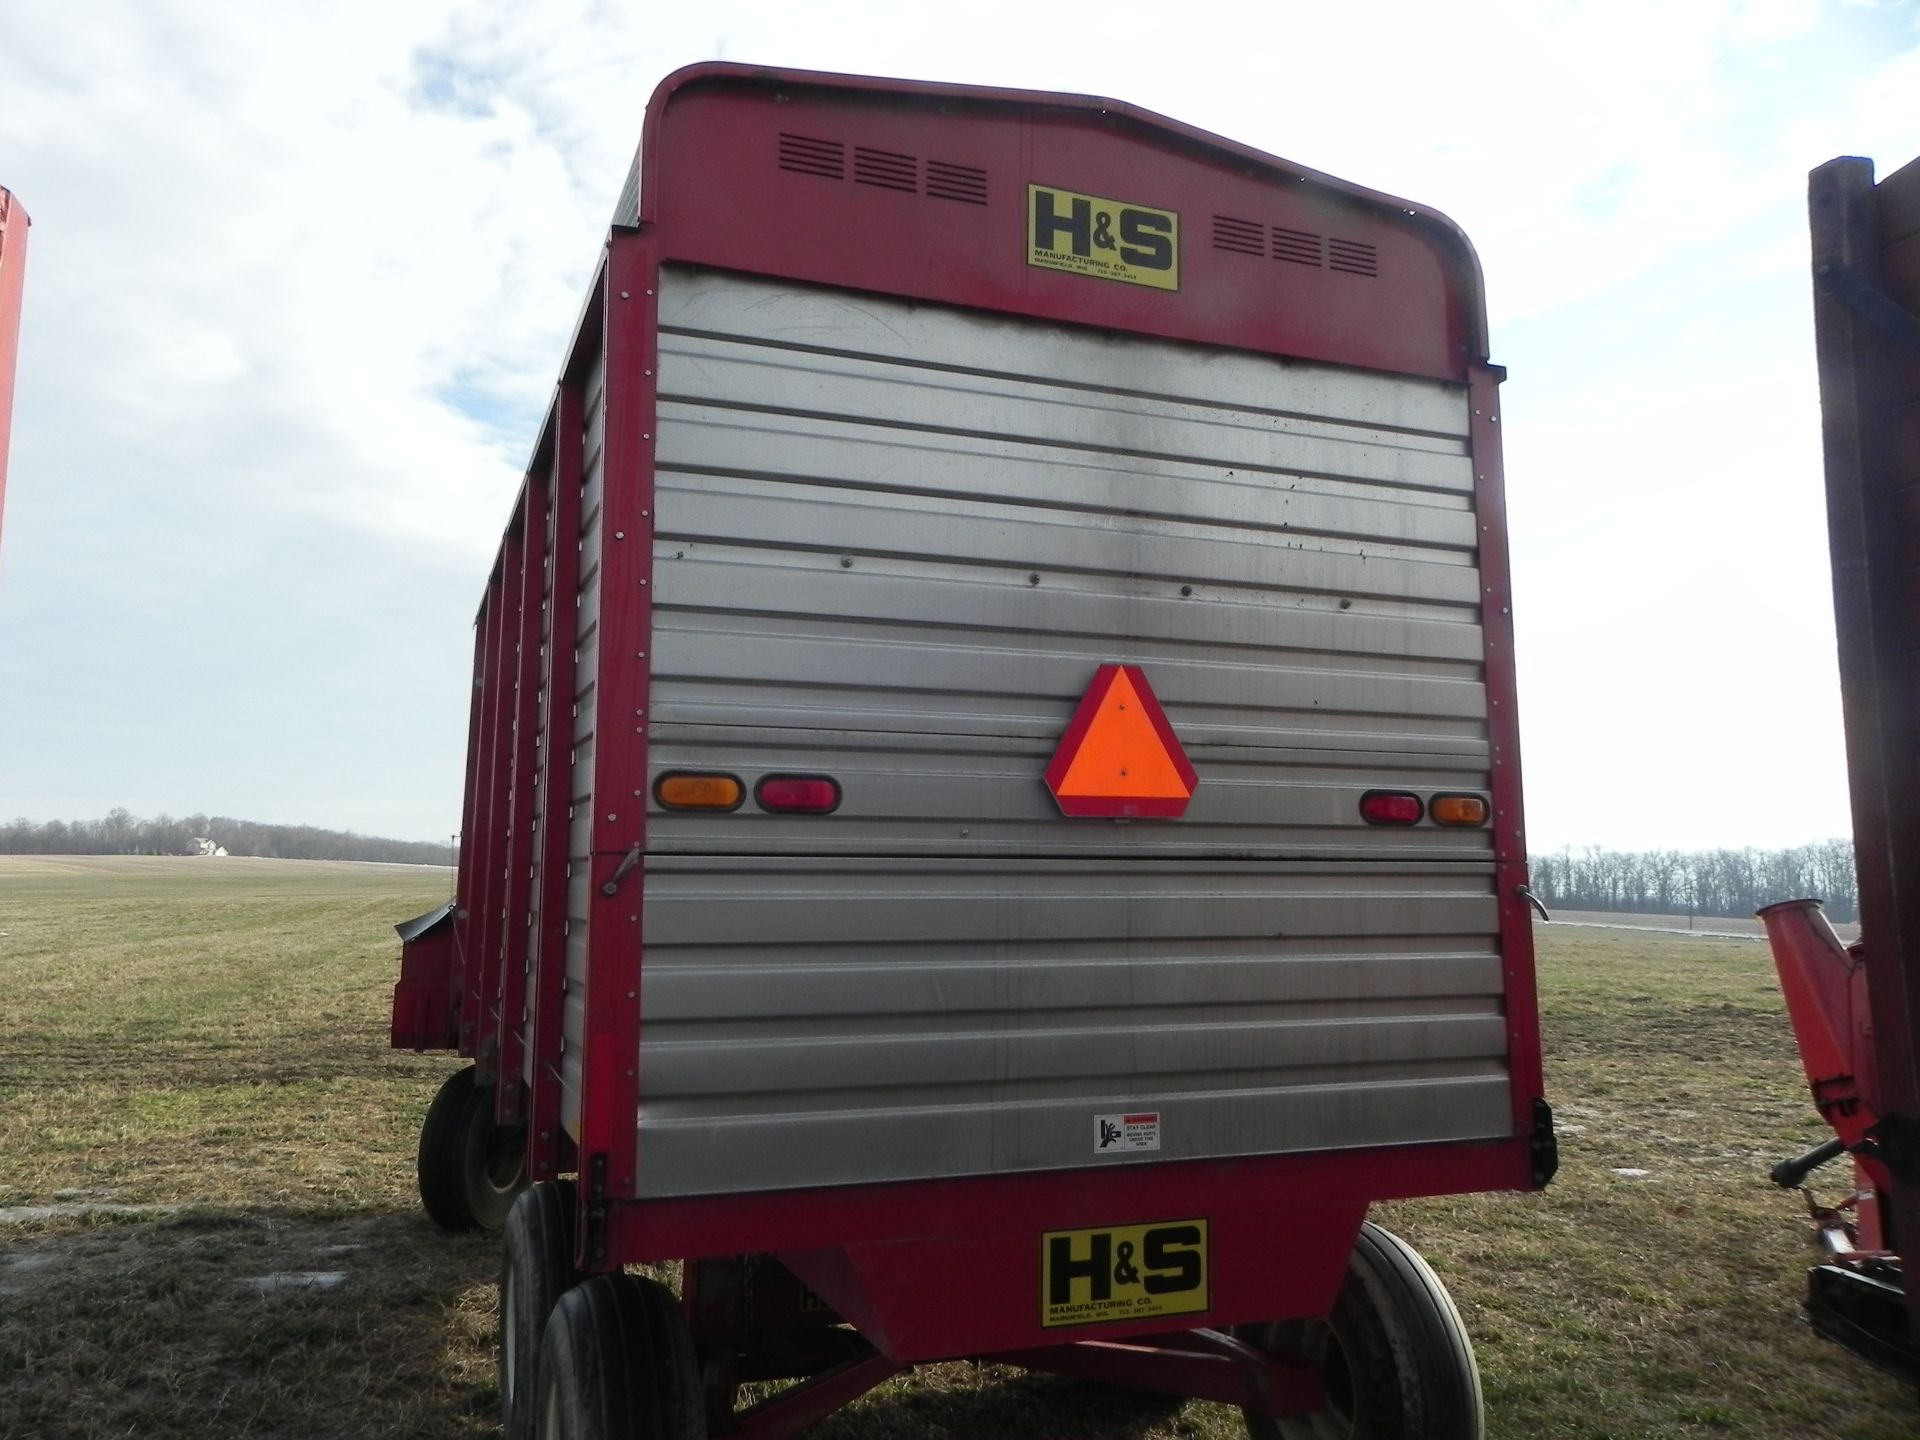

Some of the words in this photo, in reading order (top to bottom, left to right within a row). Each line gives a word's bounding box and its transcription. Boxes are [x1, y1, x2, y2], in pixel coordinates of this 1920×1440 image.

[1035, 190, 1172, 271] H&S
[1034, 249, 1110, 269] MANUFACTURING
[1114, 263, 1128, 272] CO.
[1050, 1225, 1201, 1305] H&S
[1049, 1299, 1133, 1315] MANUFACTURING
[1137, 1297, 1152, 1305] CO.
